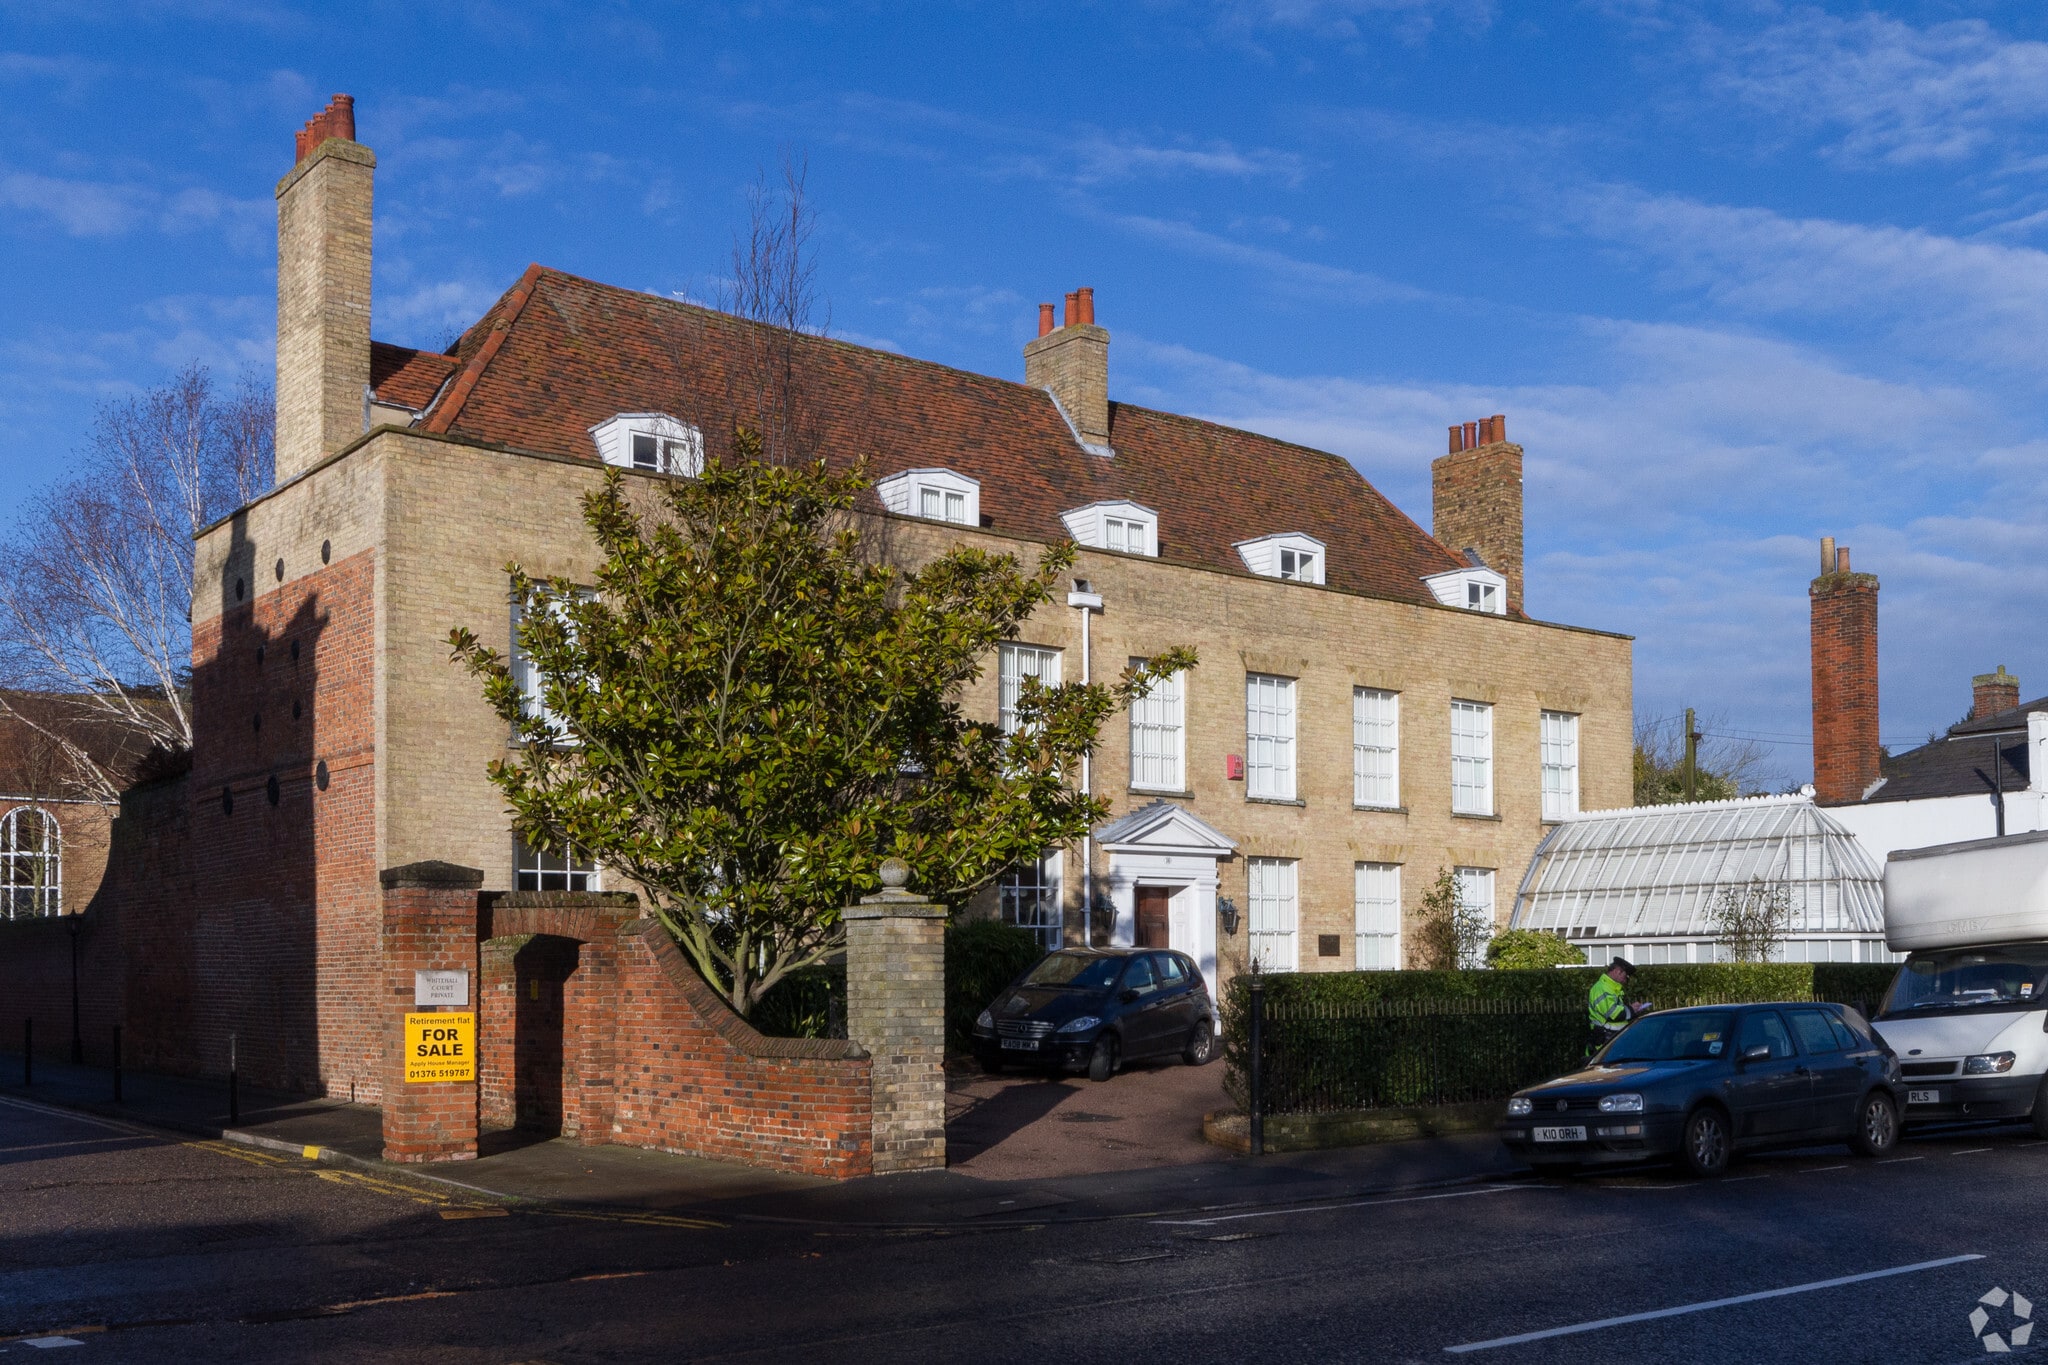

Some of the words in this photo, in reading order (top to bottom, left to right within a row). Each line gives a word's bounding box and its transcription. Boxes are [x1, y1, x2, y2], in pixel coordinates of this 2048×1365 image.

[410, 1017, 455, 1025] Retirement
[422, 1028, 459, 1041] FOR
[417, 1044, 463, 1057] SALE
[409, 1070, 437, 1078] 01376
[439, 1069, 470, 1077] 519787
[1911, 1091, 1930, 1102] RLS
